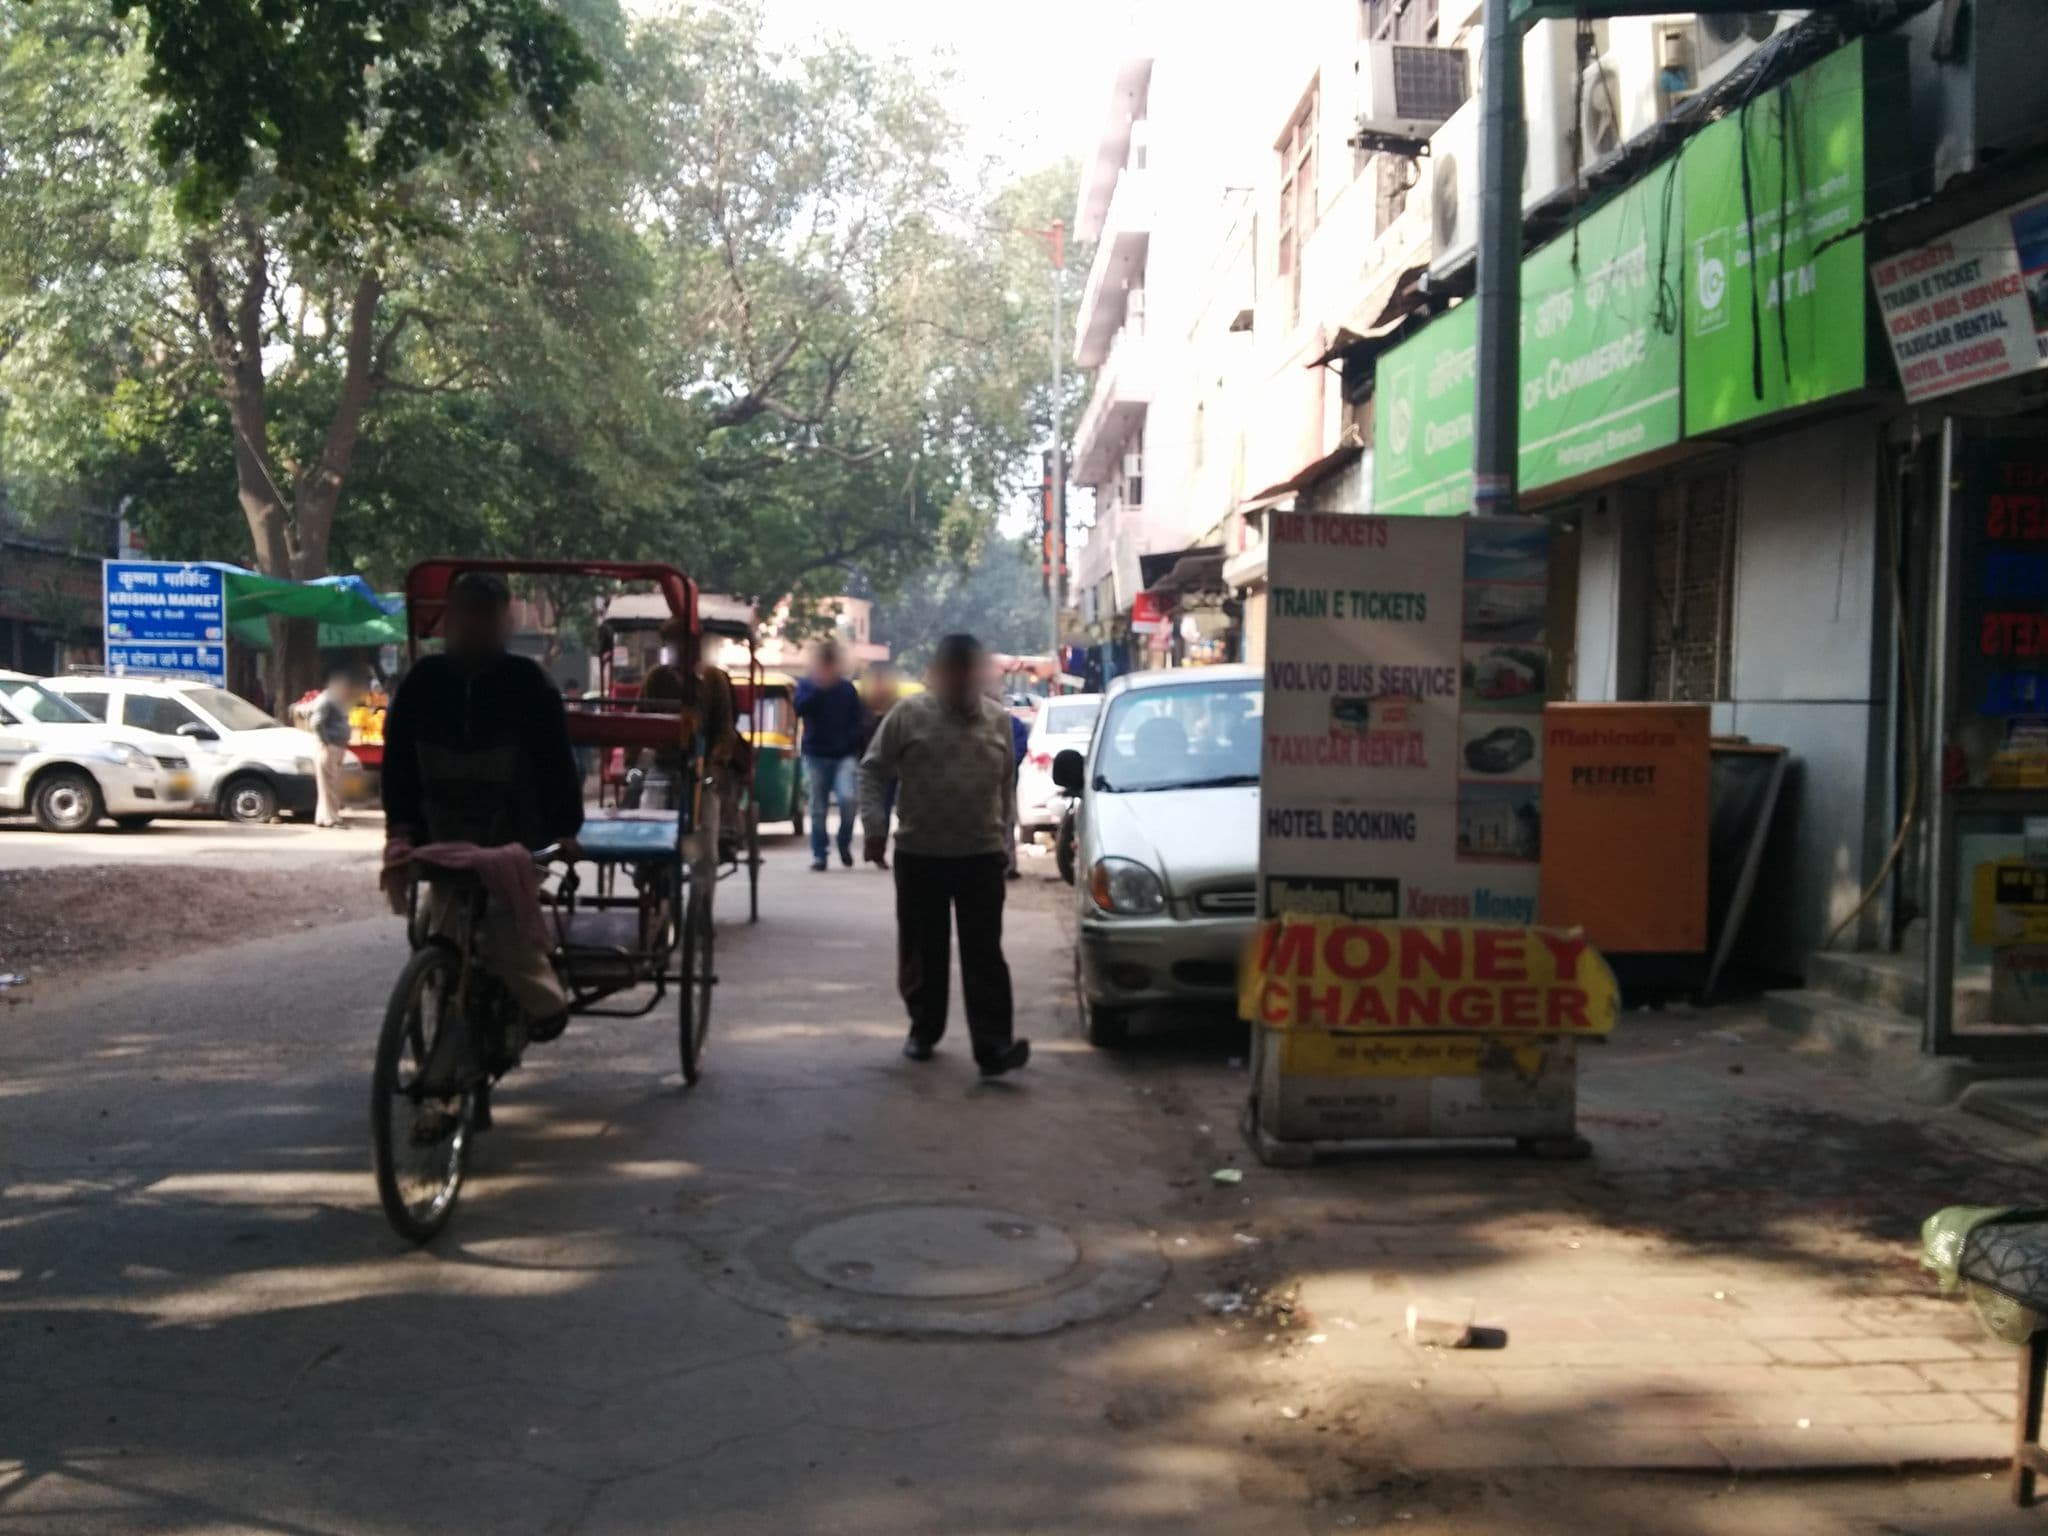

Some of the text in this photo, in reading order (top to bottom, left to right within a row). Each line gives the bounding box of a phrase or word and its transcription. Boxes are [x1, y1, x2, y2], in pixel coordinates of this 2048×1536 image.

[1765, 262, 1817, 310] ATM
[1882, 284, 1920, 311] TRAIN
[1933, 258, 1982, 293] TICKET
[1890, 273, 2022, 336] VOLVO BUS SERVICE
[1953, 309, 2009, 342] RENTAL
[1944, 338, 2007, 372] BOOKING
[1273, 517, 1389, 548] AIR TICKETS
[109, 591, 219, 608] KRISHNA MARKET
[1272, 587, 1428, 622] TRAIN E TICKETS
[1270, 661, 1457, 697] VOLVO BUS SERVICE
[1358, 732, 1429, 768] RENTAL
[1571, 765, 1657, 786] PERFECT
[1266, 808, 1417, 842] HOTEL BOOKING
[1474, 887, 1537, 925] Money
[1260, 922, 1586, 982] MONEY
[1261, 981, 1592, 1028] CHANGER
